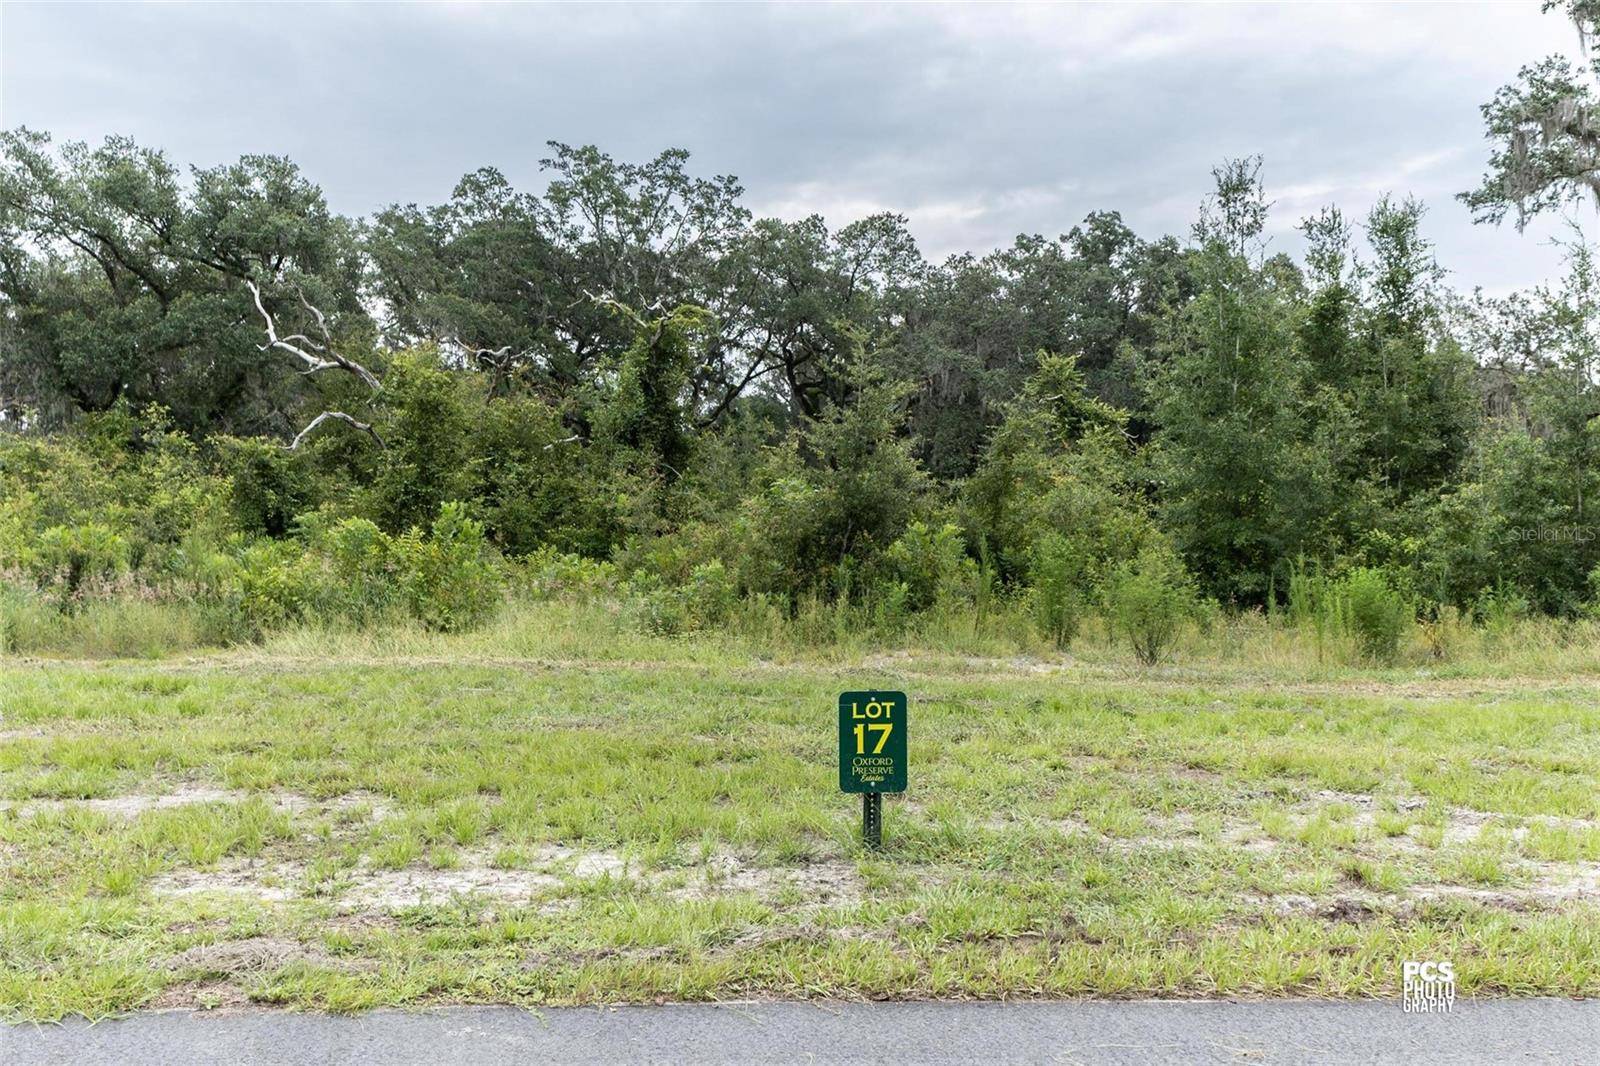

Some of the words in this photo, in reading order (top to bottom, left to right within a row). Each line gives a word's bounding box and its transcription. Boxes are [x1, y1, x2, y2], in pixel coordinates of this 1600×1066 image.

[852, 702, 895, 719] LOT
[853, 723, 893, 754] 17
[852, 766, 895, 776] PRESERVE
